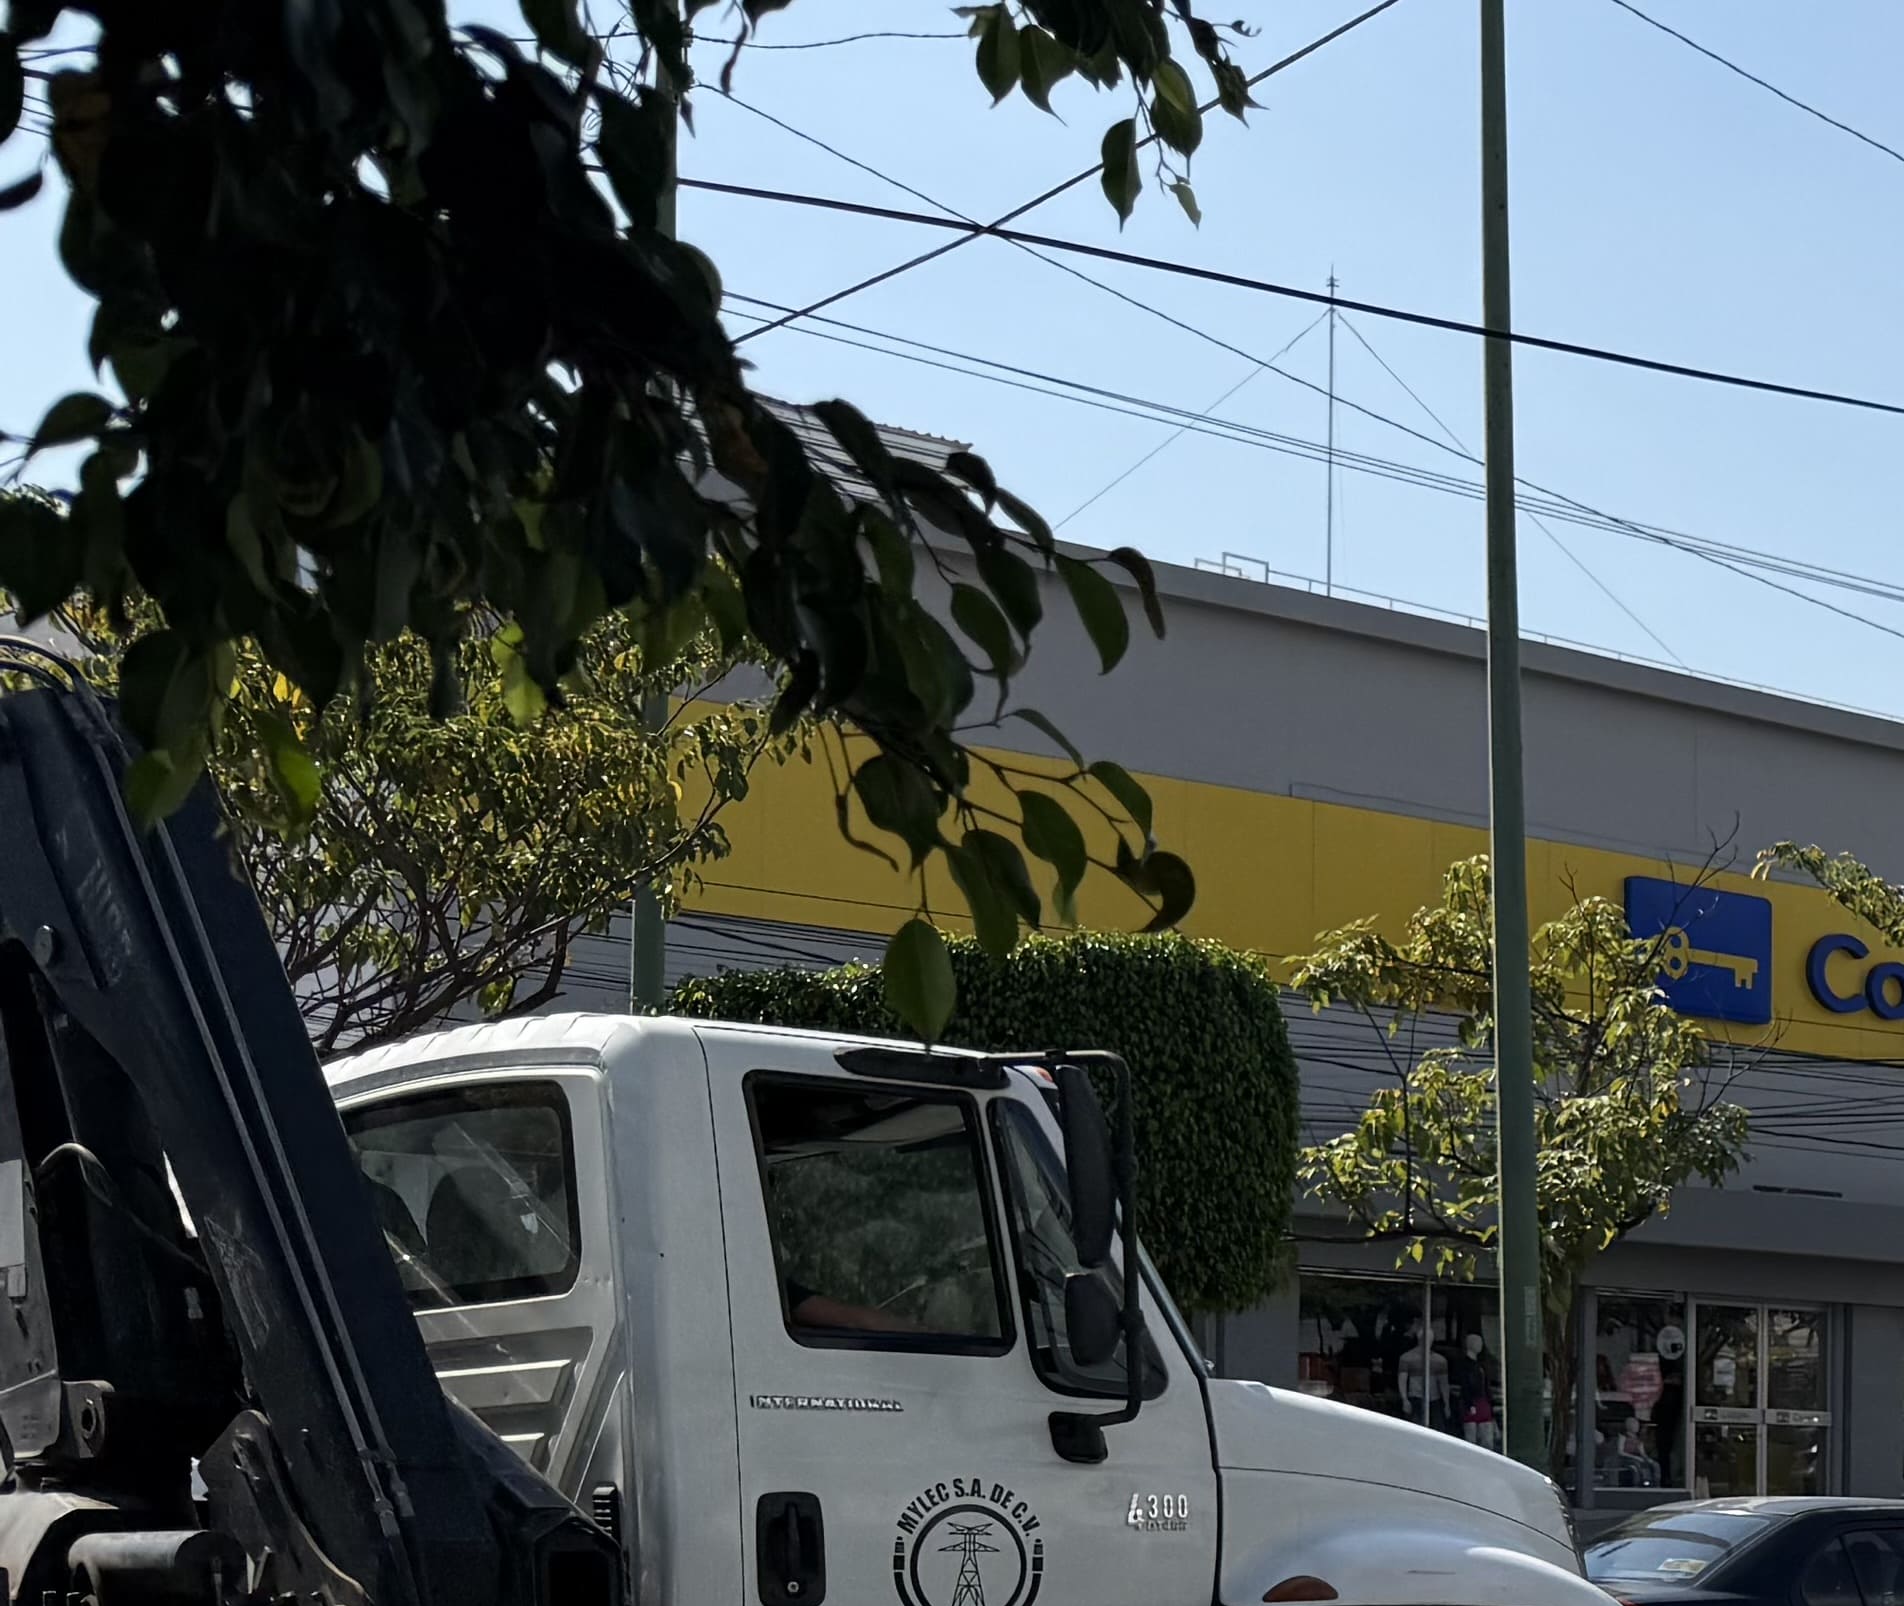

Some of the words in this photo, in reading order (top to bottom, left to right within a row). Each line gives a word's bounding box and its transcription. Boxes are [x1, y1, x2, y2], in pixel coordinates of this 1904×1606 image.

[896, 1482, 950, 1535] MYLEC
[953, 1477, 986, 1499] S.A.
[990, 1483, 1016, 1509] DE
[1011, 1502, 1041, 1537] C.V.
[1128, 1493, 1189, 1524] 4300
